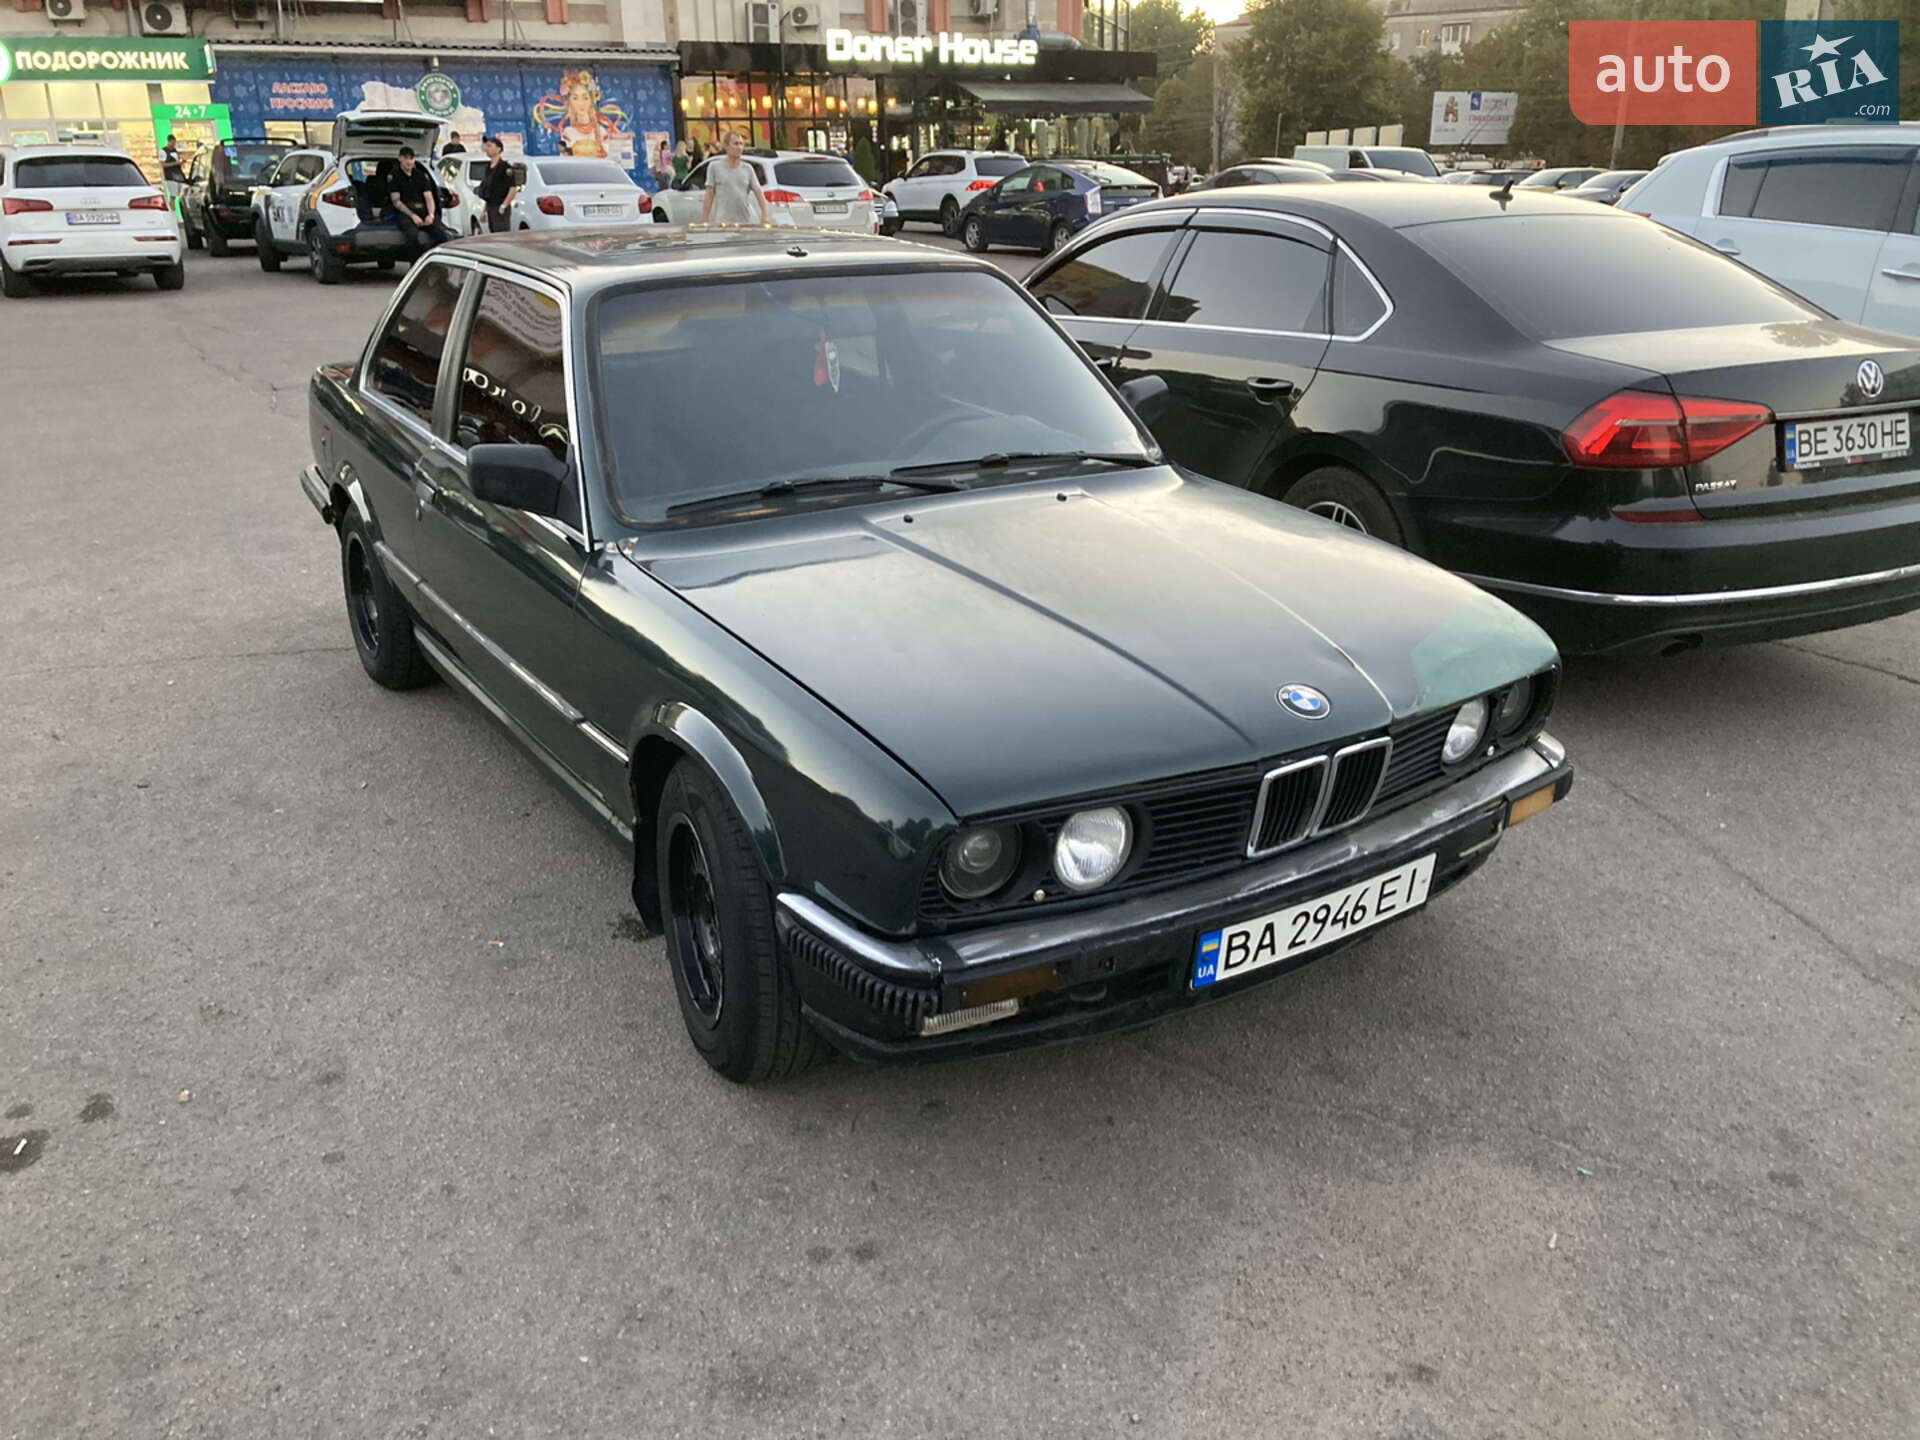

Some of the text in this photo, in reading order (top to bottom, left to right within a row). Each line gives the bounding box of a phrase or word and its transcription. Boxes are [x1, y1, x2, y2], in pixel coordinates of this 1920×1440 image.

[15, 50, 190, 71] ПОДОРОЖНИК
[826, 28, 1039, 65] Doner House
[1798, 418, 1907, 458] BE 3630 HE
[1223, 867, 1418, 972] BA 2946 EI
[1198, 964, 1215, 979] UA
